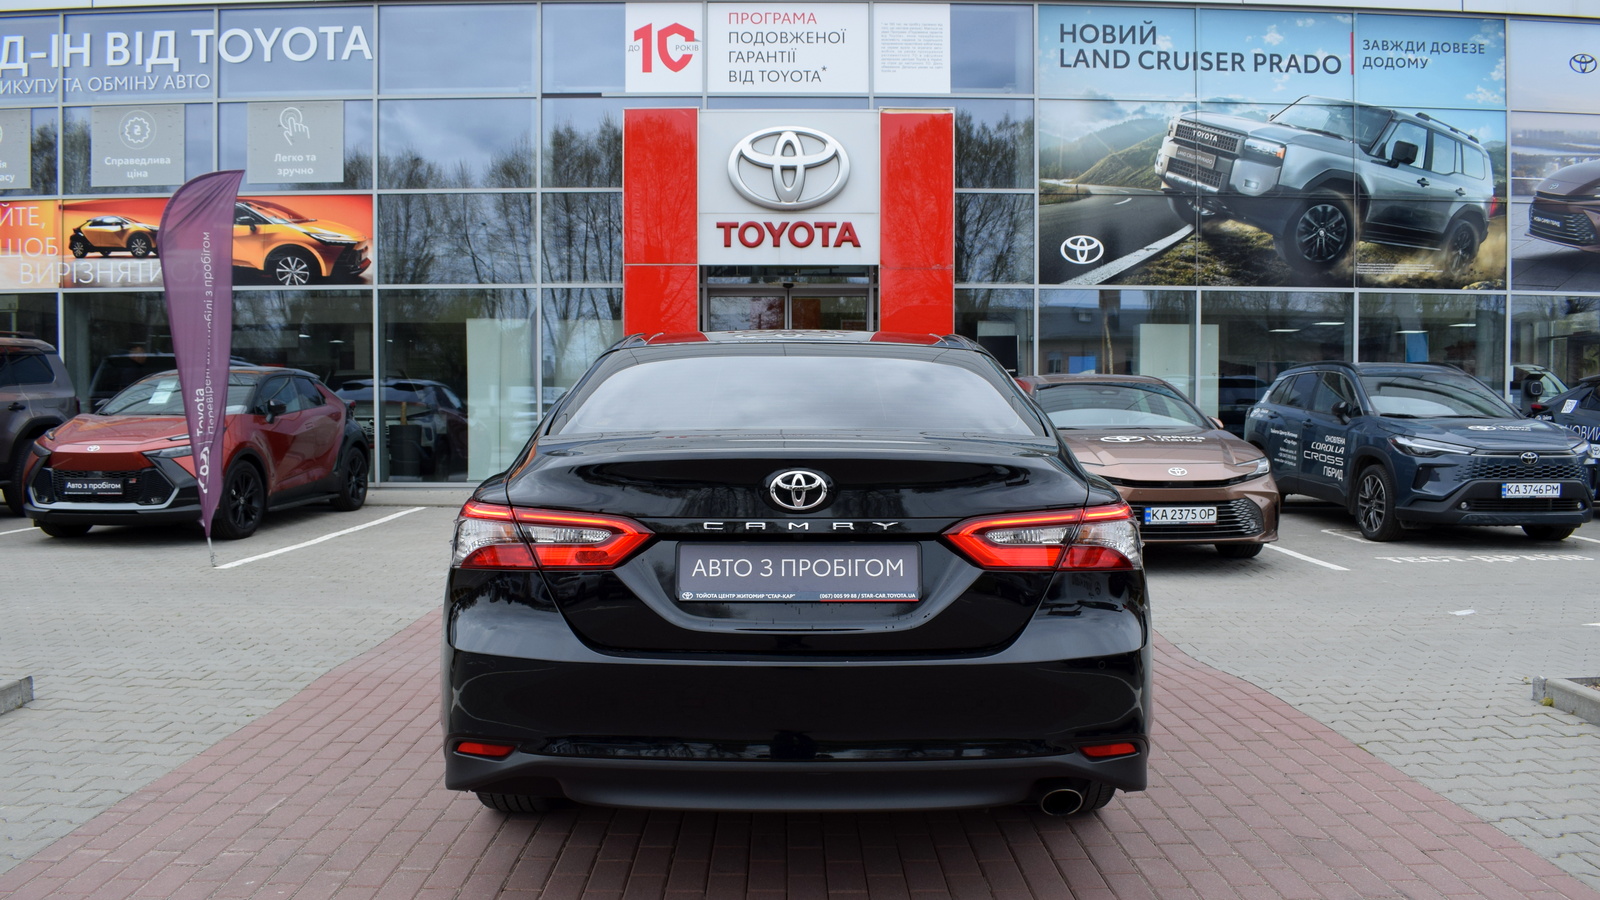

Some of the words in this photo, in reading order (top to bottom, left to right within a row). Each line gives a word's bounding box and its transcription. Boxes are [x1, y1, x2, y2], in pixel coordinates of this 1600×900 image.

[728, 12, 817, 25] ПРОГРАМА
[728, 28, 847, 47] ПОДОВЖЕНОЇ
[1060, 20, 1158, 46] НОВИЙ
[106, 30, 180, 73] ВІД
[191, 26, 374, 64] TOYOTA
[628, 45, 640, 53] ДО
[1363, 38, 1427, 54] ЗАВЖДИ
[1430, 41, 1486, 56] ДОВЕЗЕ
[728, 48, 796, 63] ГАРАНТІЇ
[1060, 46, 1131, 70] LAND
[1137, 49, 1246, 73] CRUISER
[1253, 52, 1342, 75] PRADO
[1363, 56, 1430, 71] ДОДОМУ
[62, 78, 83, 93] ТА
[88, 75, 158, 92] ОБМІНУ
[164, 74, 211, 90] АВТО
[728, 70, 754, 85] ВІД
[1192, 129, 1218, 142] TOYOTA
[104, 156, 171, 167] Справедлива
[274, 153, 302, 162] Легко
[127, 170, 148, 179] ціна
[277, 166, 314, 176] зручно
[716, 221, 861, 248] TOYOTA
[0, 236, 59, 262] ЩОБ
[201, 231, 214, 287] пробігом
[1311, 441, 1345, 454] COROLLA
[1325, 435, 1345, 445] ОНОВЛЕНА
[1304, 450, 1343, 466] CROSS
[1323, 465, 1343, 481] ГІБРИД
[89, 482, 121, 490] пробігом
[1507, 485, 1520, 495] KA
[1522, 485, 1544, 495] 3746
[1545, 485, 1559, 494] PM
[1152, 509, 1168, 520] KA
[1170, 509, 1197, 520] 2375
[1199, 508, 1215, 520] OP
[703, 522, 898, 530] CAMRY
[692, 558, 753, 578] АВТО
[760, 558, 773, 578] З
[781, 558, 904, 578] ПРОБІГОМ
